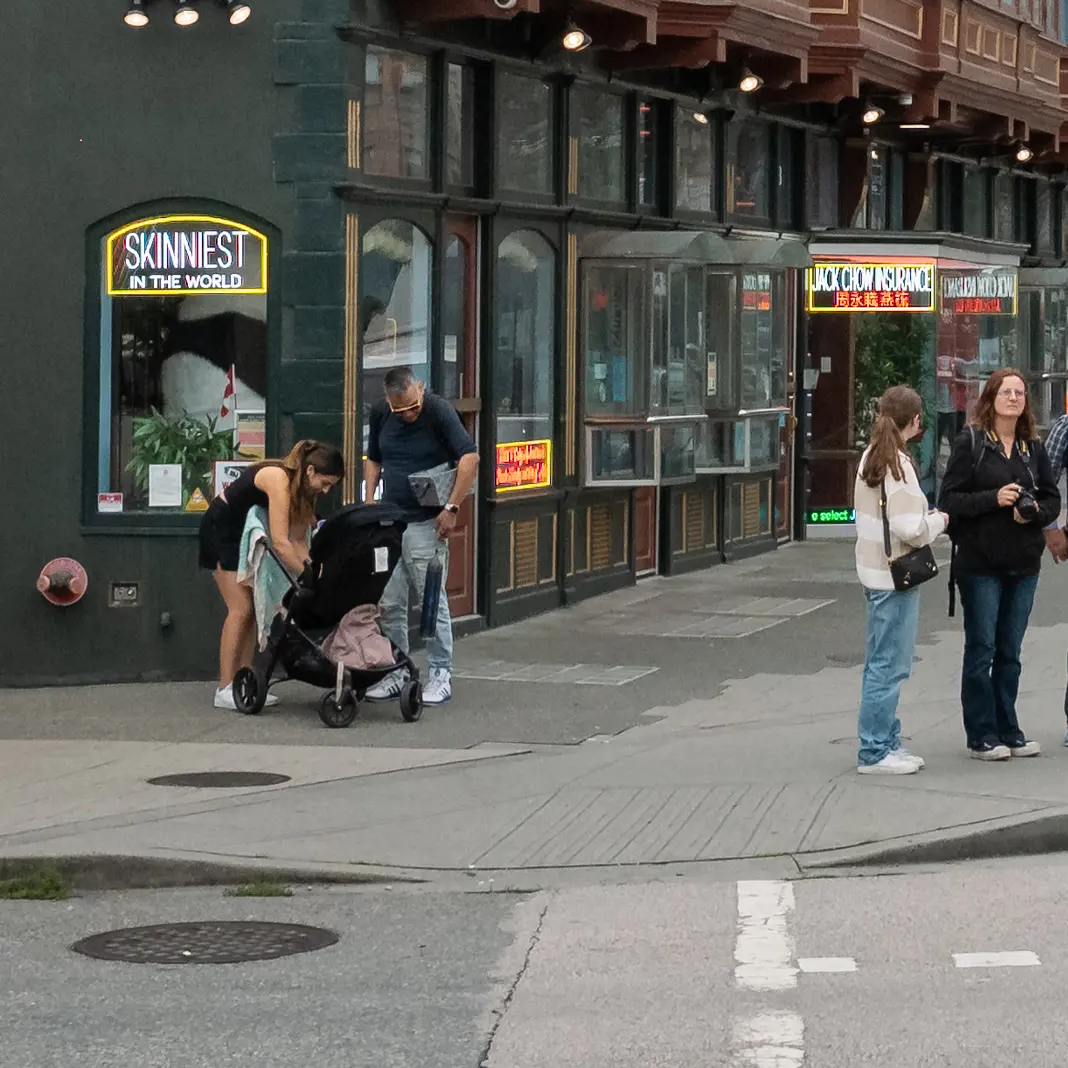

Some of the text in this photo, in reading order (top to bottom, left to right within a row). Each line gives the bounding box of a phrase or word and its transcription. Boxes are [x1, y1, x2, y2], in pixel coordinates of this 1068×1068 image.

[125, 231, 249, 270] SKINNIEST
[129, 273, 242, 289] IN THE WORLD
[812, 267, 932, 292] JACK CHOW INSURANCE
[820, 510, 848, 521] select
